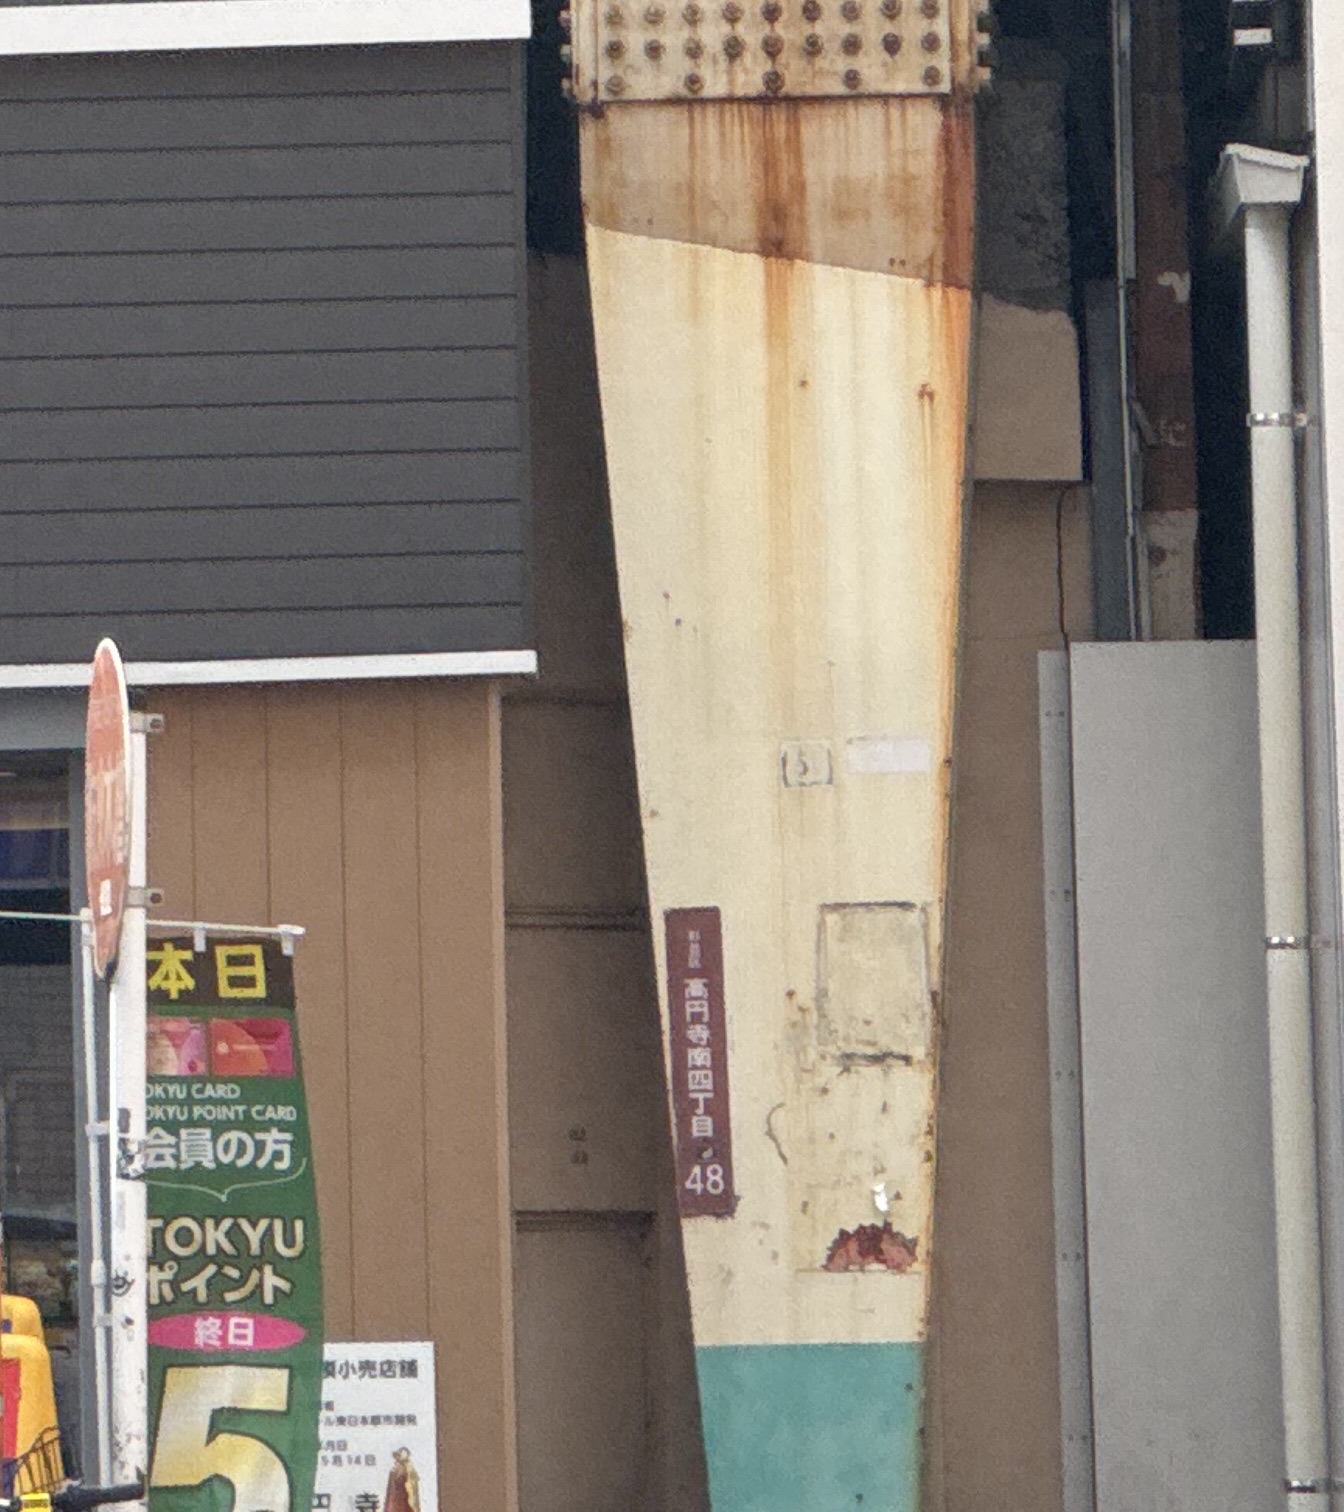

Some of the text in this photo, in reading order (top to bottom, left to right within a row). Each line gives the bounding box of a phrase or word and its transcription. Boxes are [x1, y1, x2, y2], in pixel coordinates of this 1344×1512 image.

[146, 942, 267, 1000] 本日
[684, 978, 714, 1138] 高円寺南四丁目
[191, 1083, 241, 1099] CARD
[193, 1105, 248, 1121] POINT
[251, 1105, 297, 1121] CARD
[146, 1126, 294, 1171] 会員の方
[685, 1163, 725, 1195] 48
[148, 1260, 292, 1305] ポイント
[194, 1316, 254, 1347] 終日
